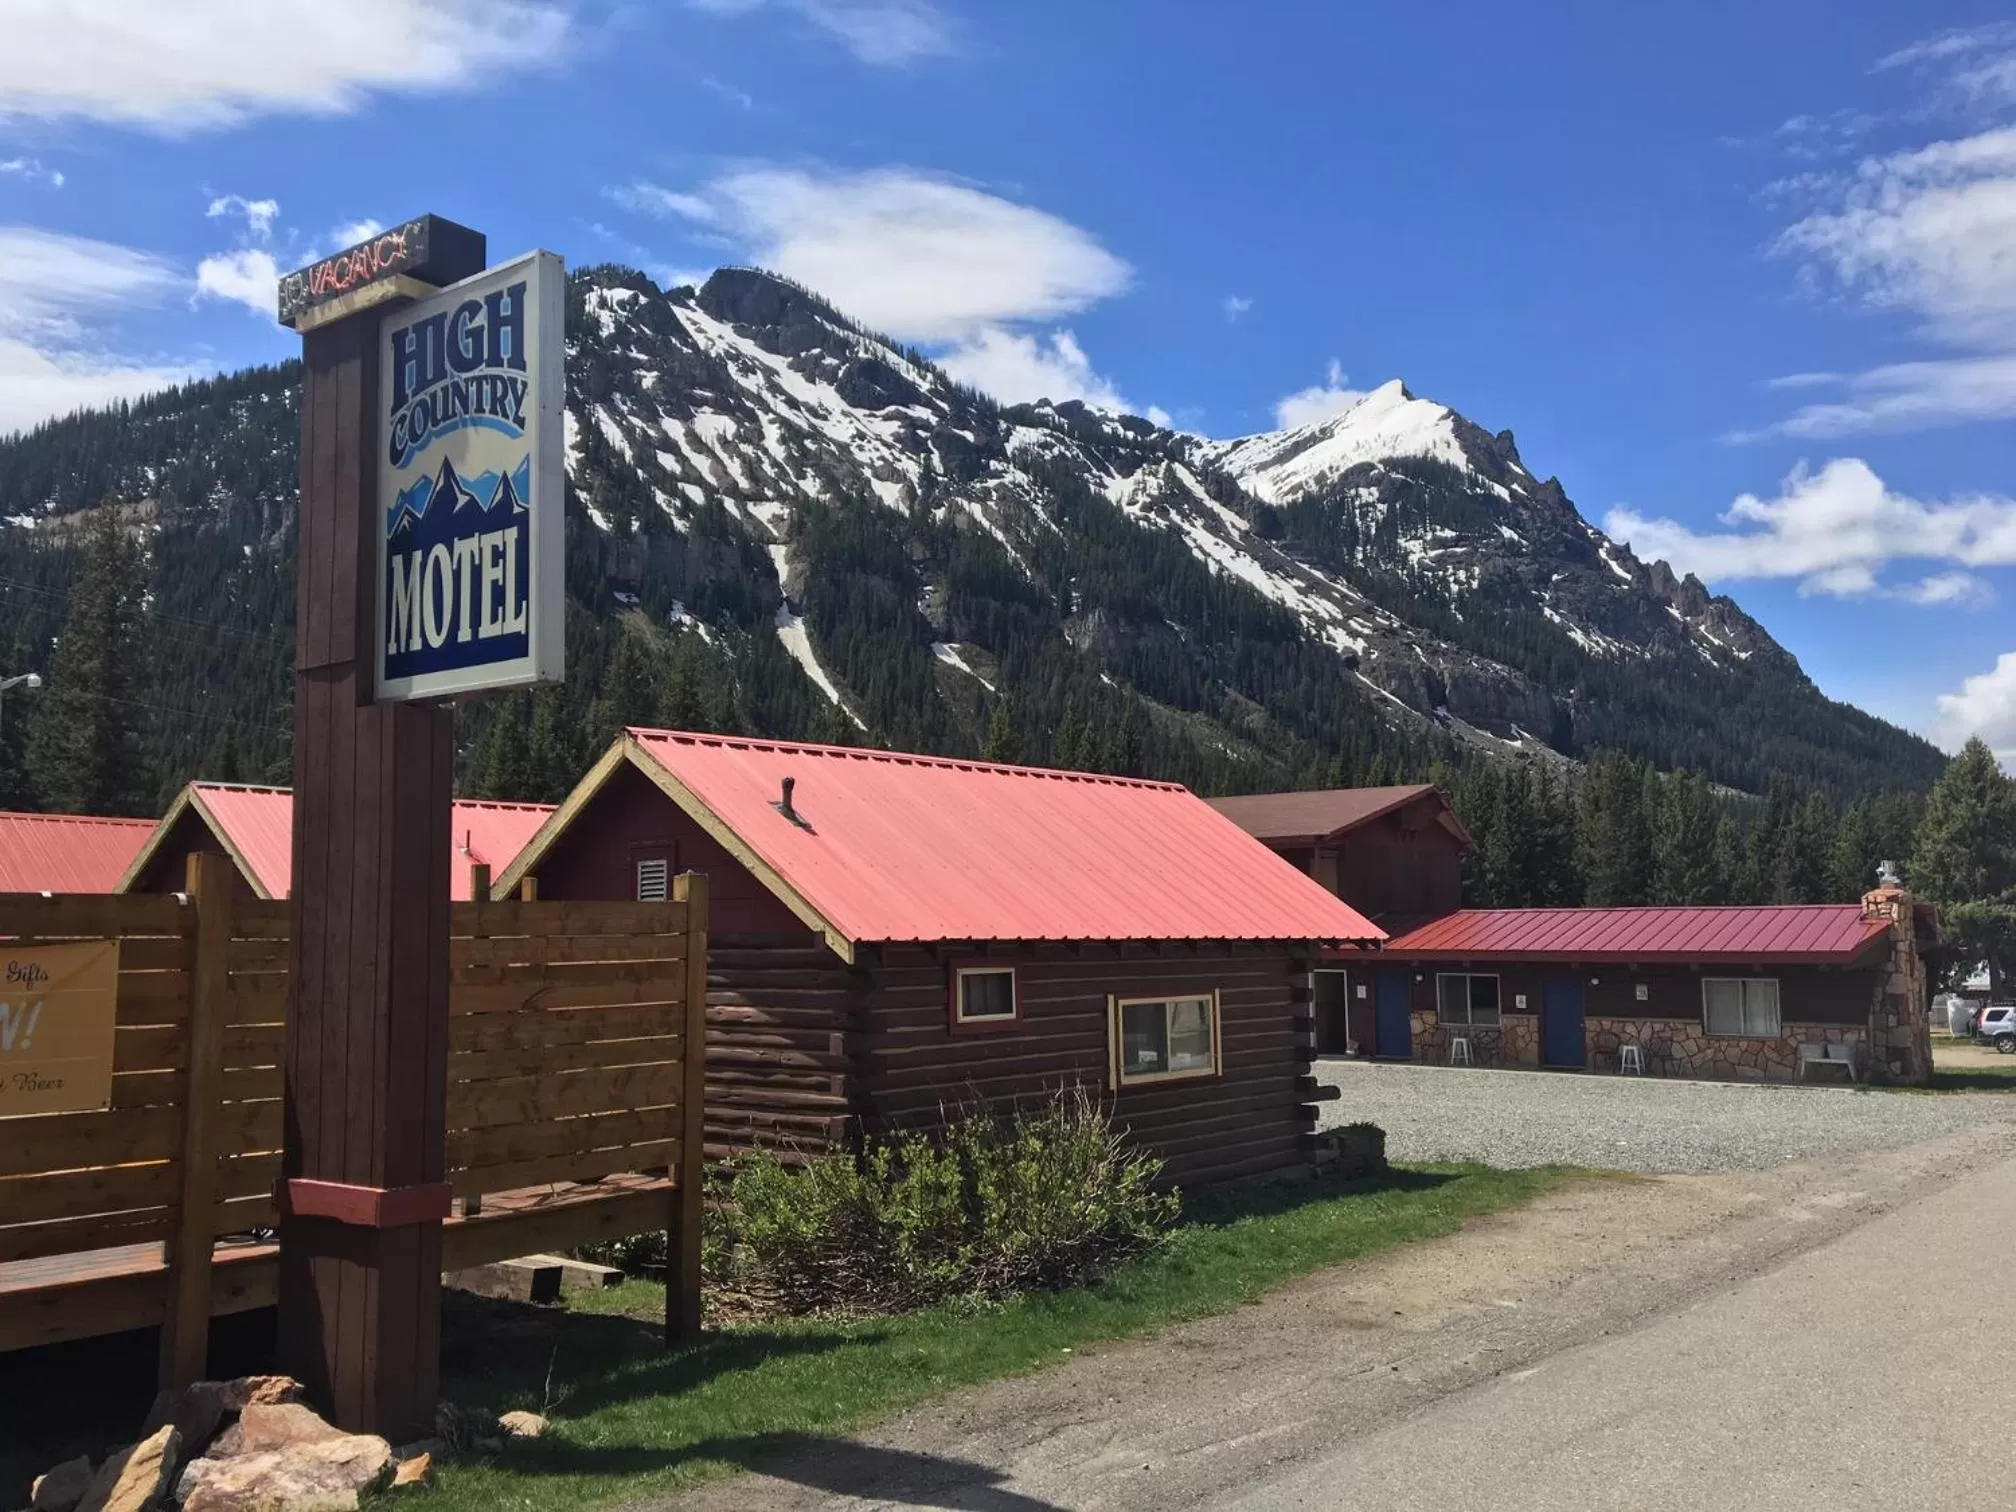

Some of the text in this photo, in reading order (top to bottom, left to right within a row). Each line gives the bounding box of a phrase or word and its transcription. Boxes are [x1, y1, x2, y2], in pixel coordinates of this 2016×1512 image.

[308, 223, 415, 295] VACANCY
[391, 281, 527, 416] HIGH
[390, 374, 528, 467] COUNTRY
[388, 526, 527, 655] MOTEL
[6, 960, 49, 991] Gifts
